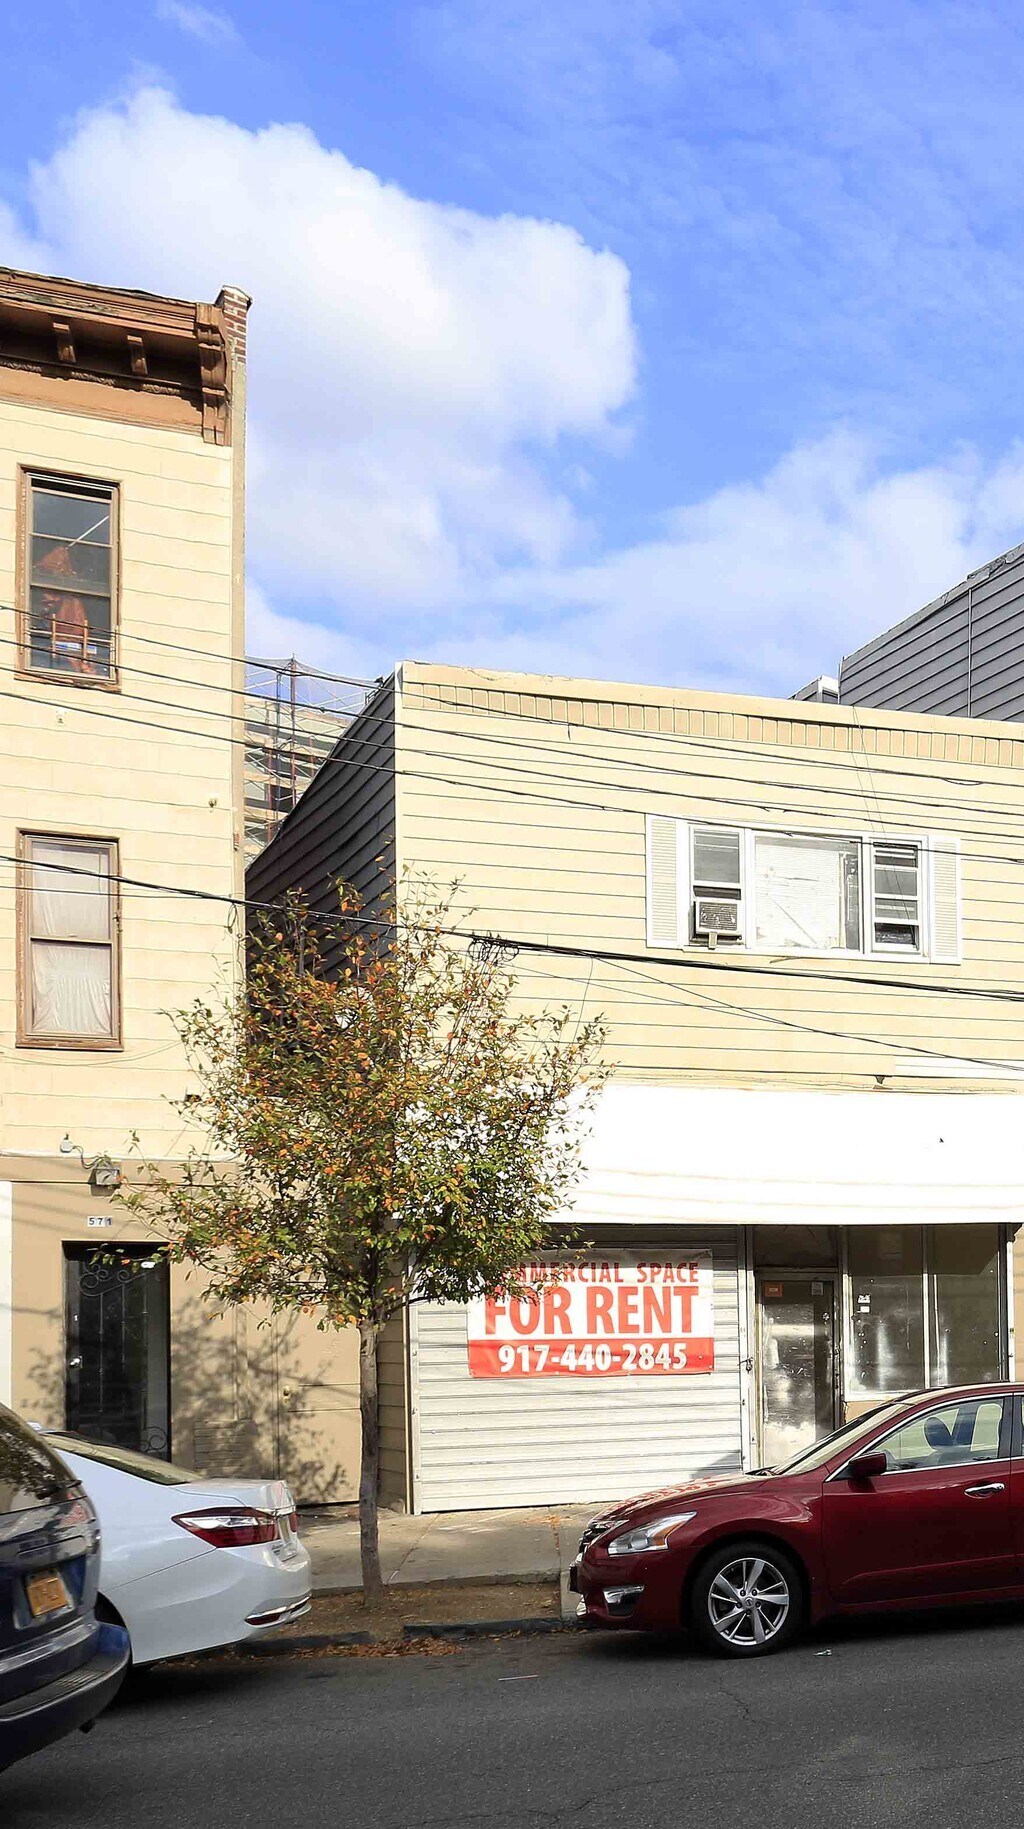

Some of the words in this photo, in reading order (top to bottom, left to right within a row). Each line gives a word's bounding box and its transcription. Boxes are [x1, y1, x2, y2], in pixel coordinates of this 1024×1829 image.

[89, 1217, 112, 1226] 571
[506, 1261, 624, 1283] MMERCIAL
[637, 1261, 699, 1283] SPACE
[484, 1286, 574, 1336] FOR
[586, 1285, 699, 1335] RENT
[498, 1343, 688, 1373] 917-440-2845
